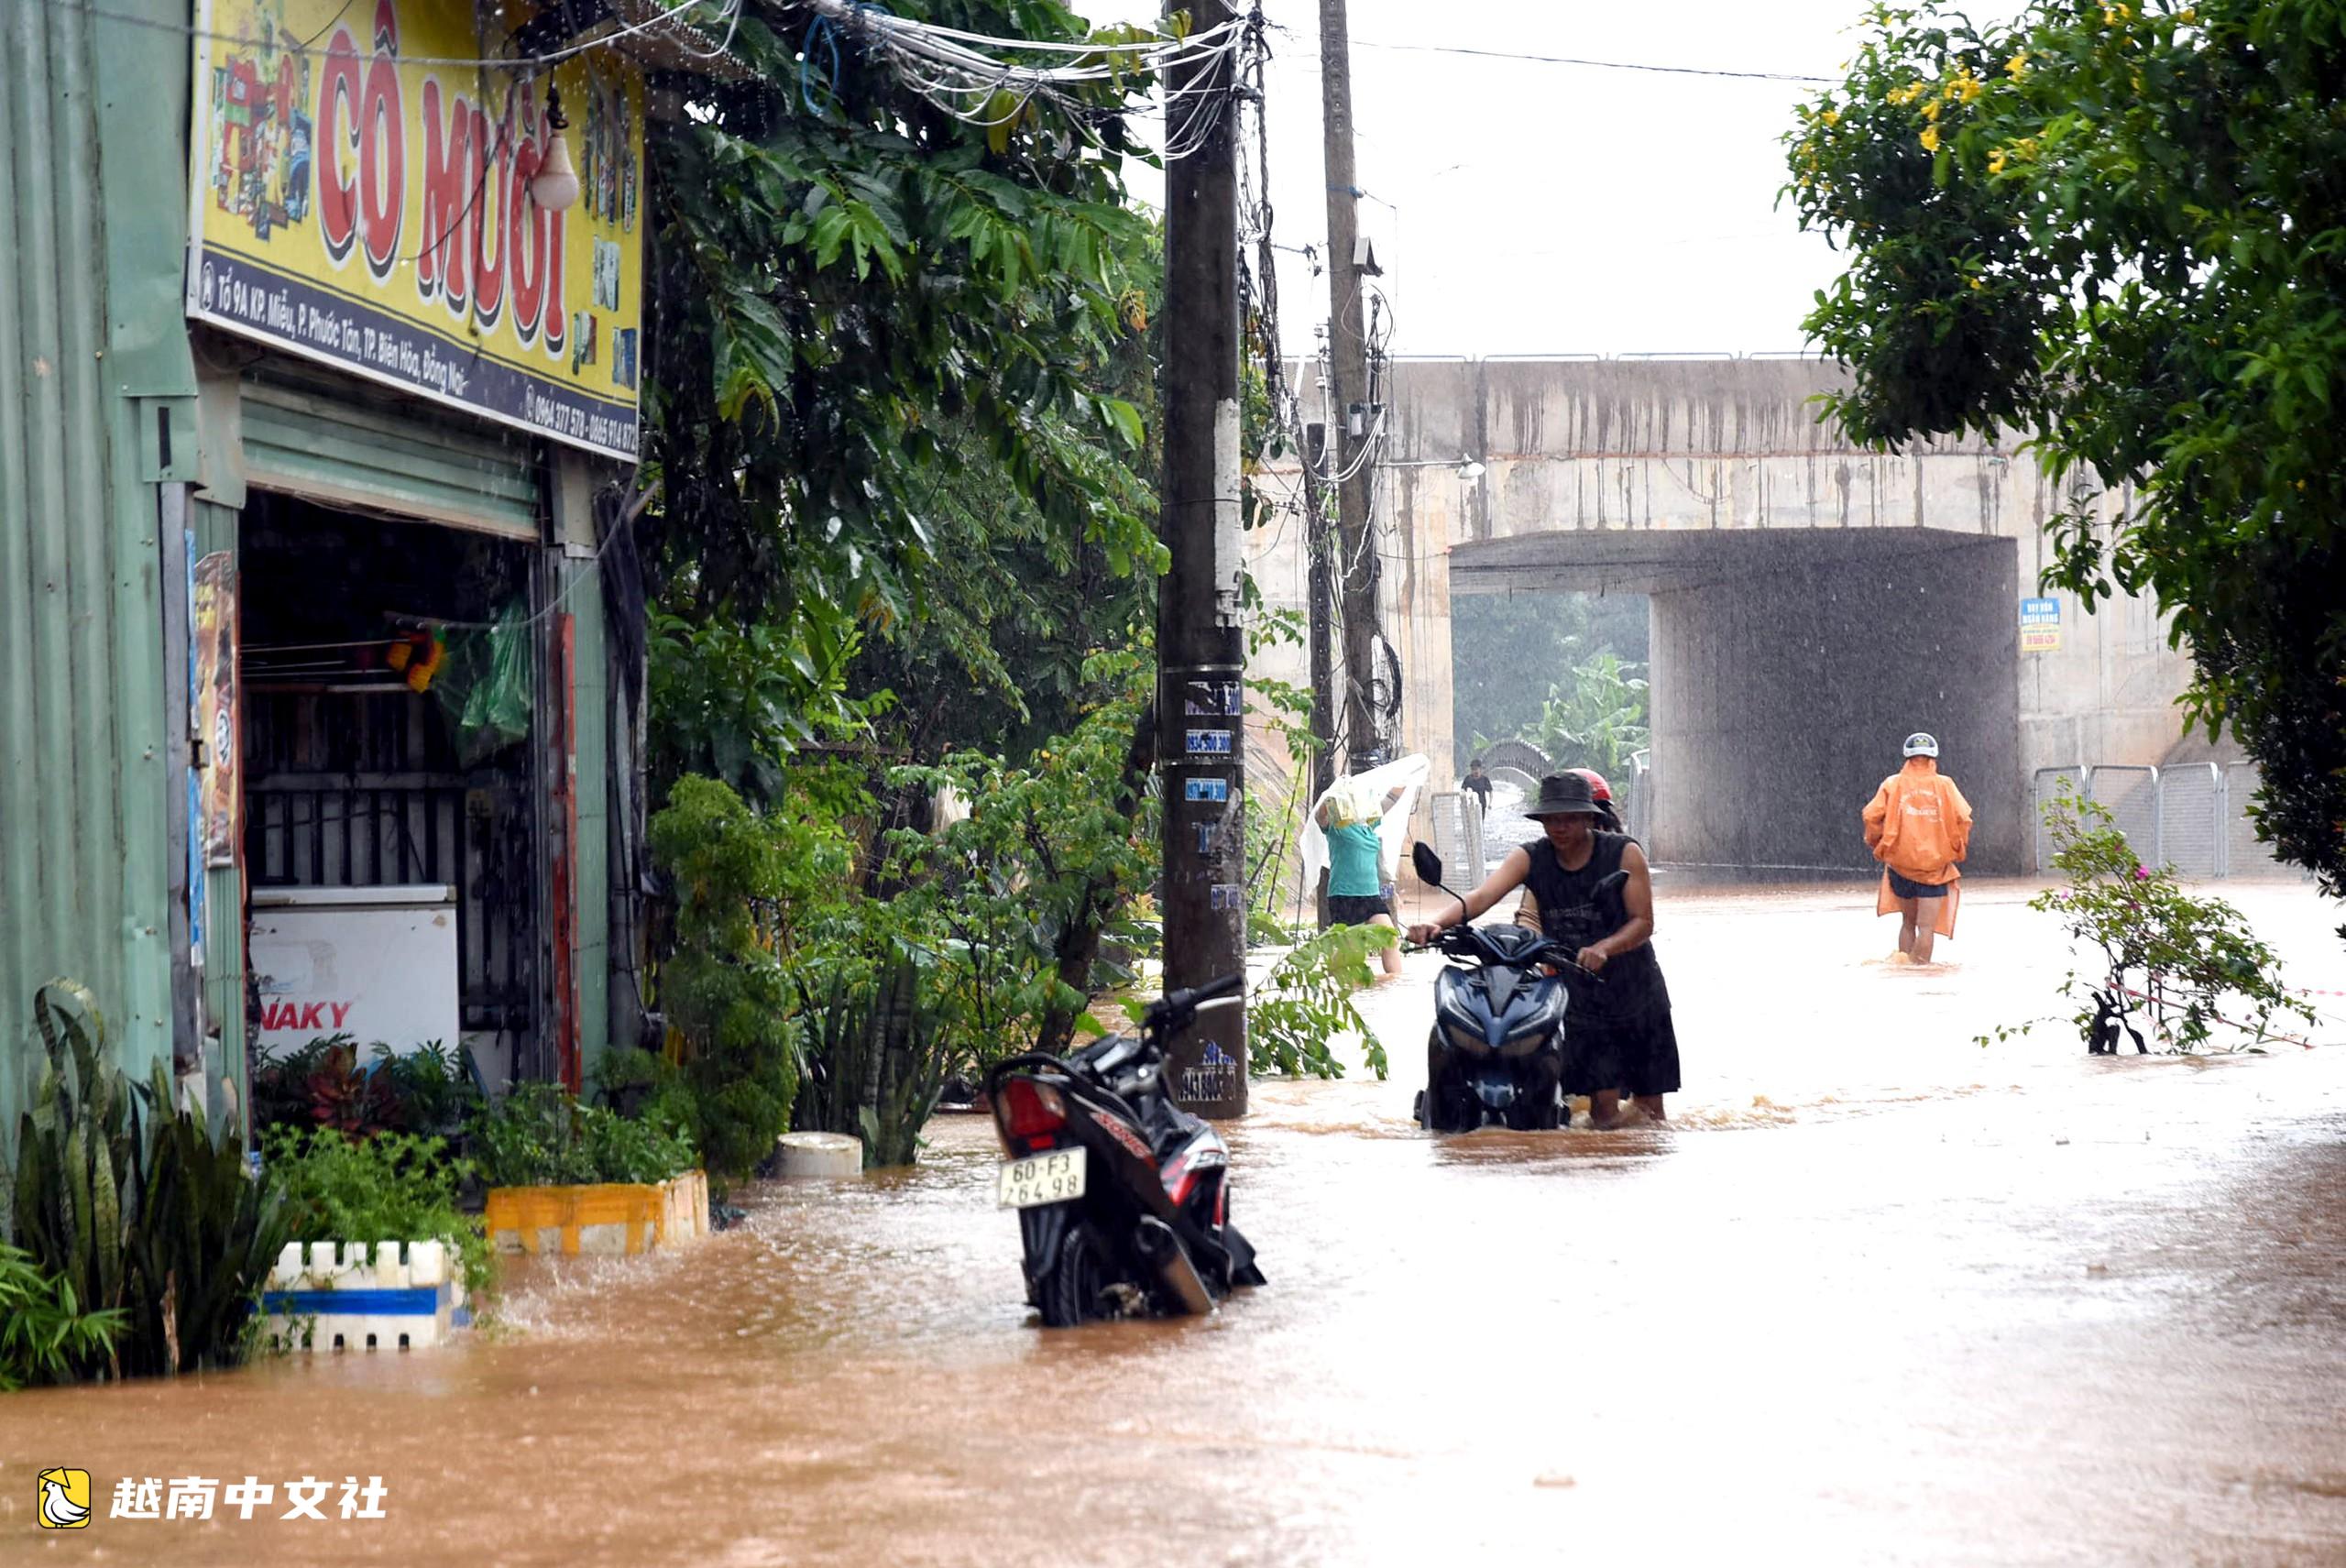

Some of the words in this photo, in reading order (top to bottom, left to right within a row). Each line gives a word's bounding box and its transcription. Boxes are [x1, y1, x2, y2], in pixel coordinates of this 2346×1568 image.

[233, 280, 247, 318] 9A
[250, 286, 266, 323] KP.
[298, 302, 307, 336] P.
[308, 306, 340, 348] Phước
[364, 326, 377, 360] TP.
[378, 332, 398, 369] Biên
